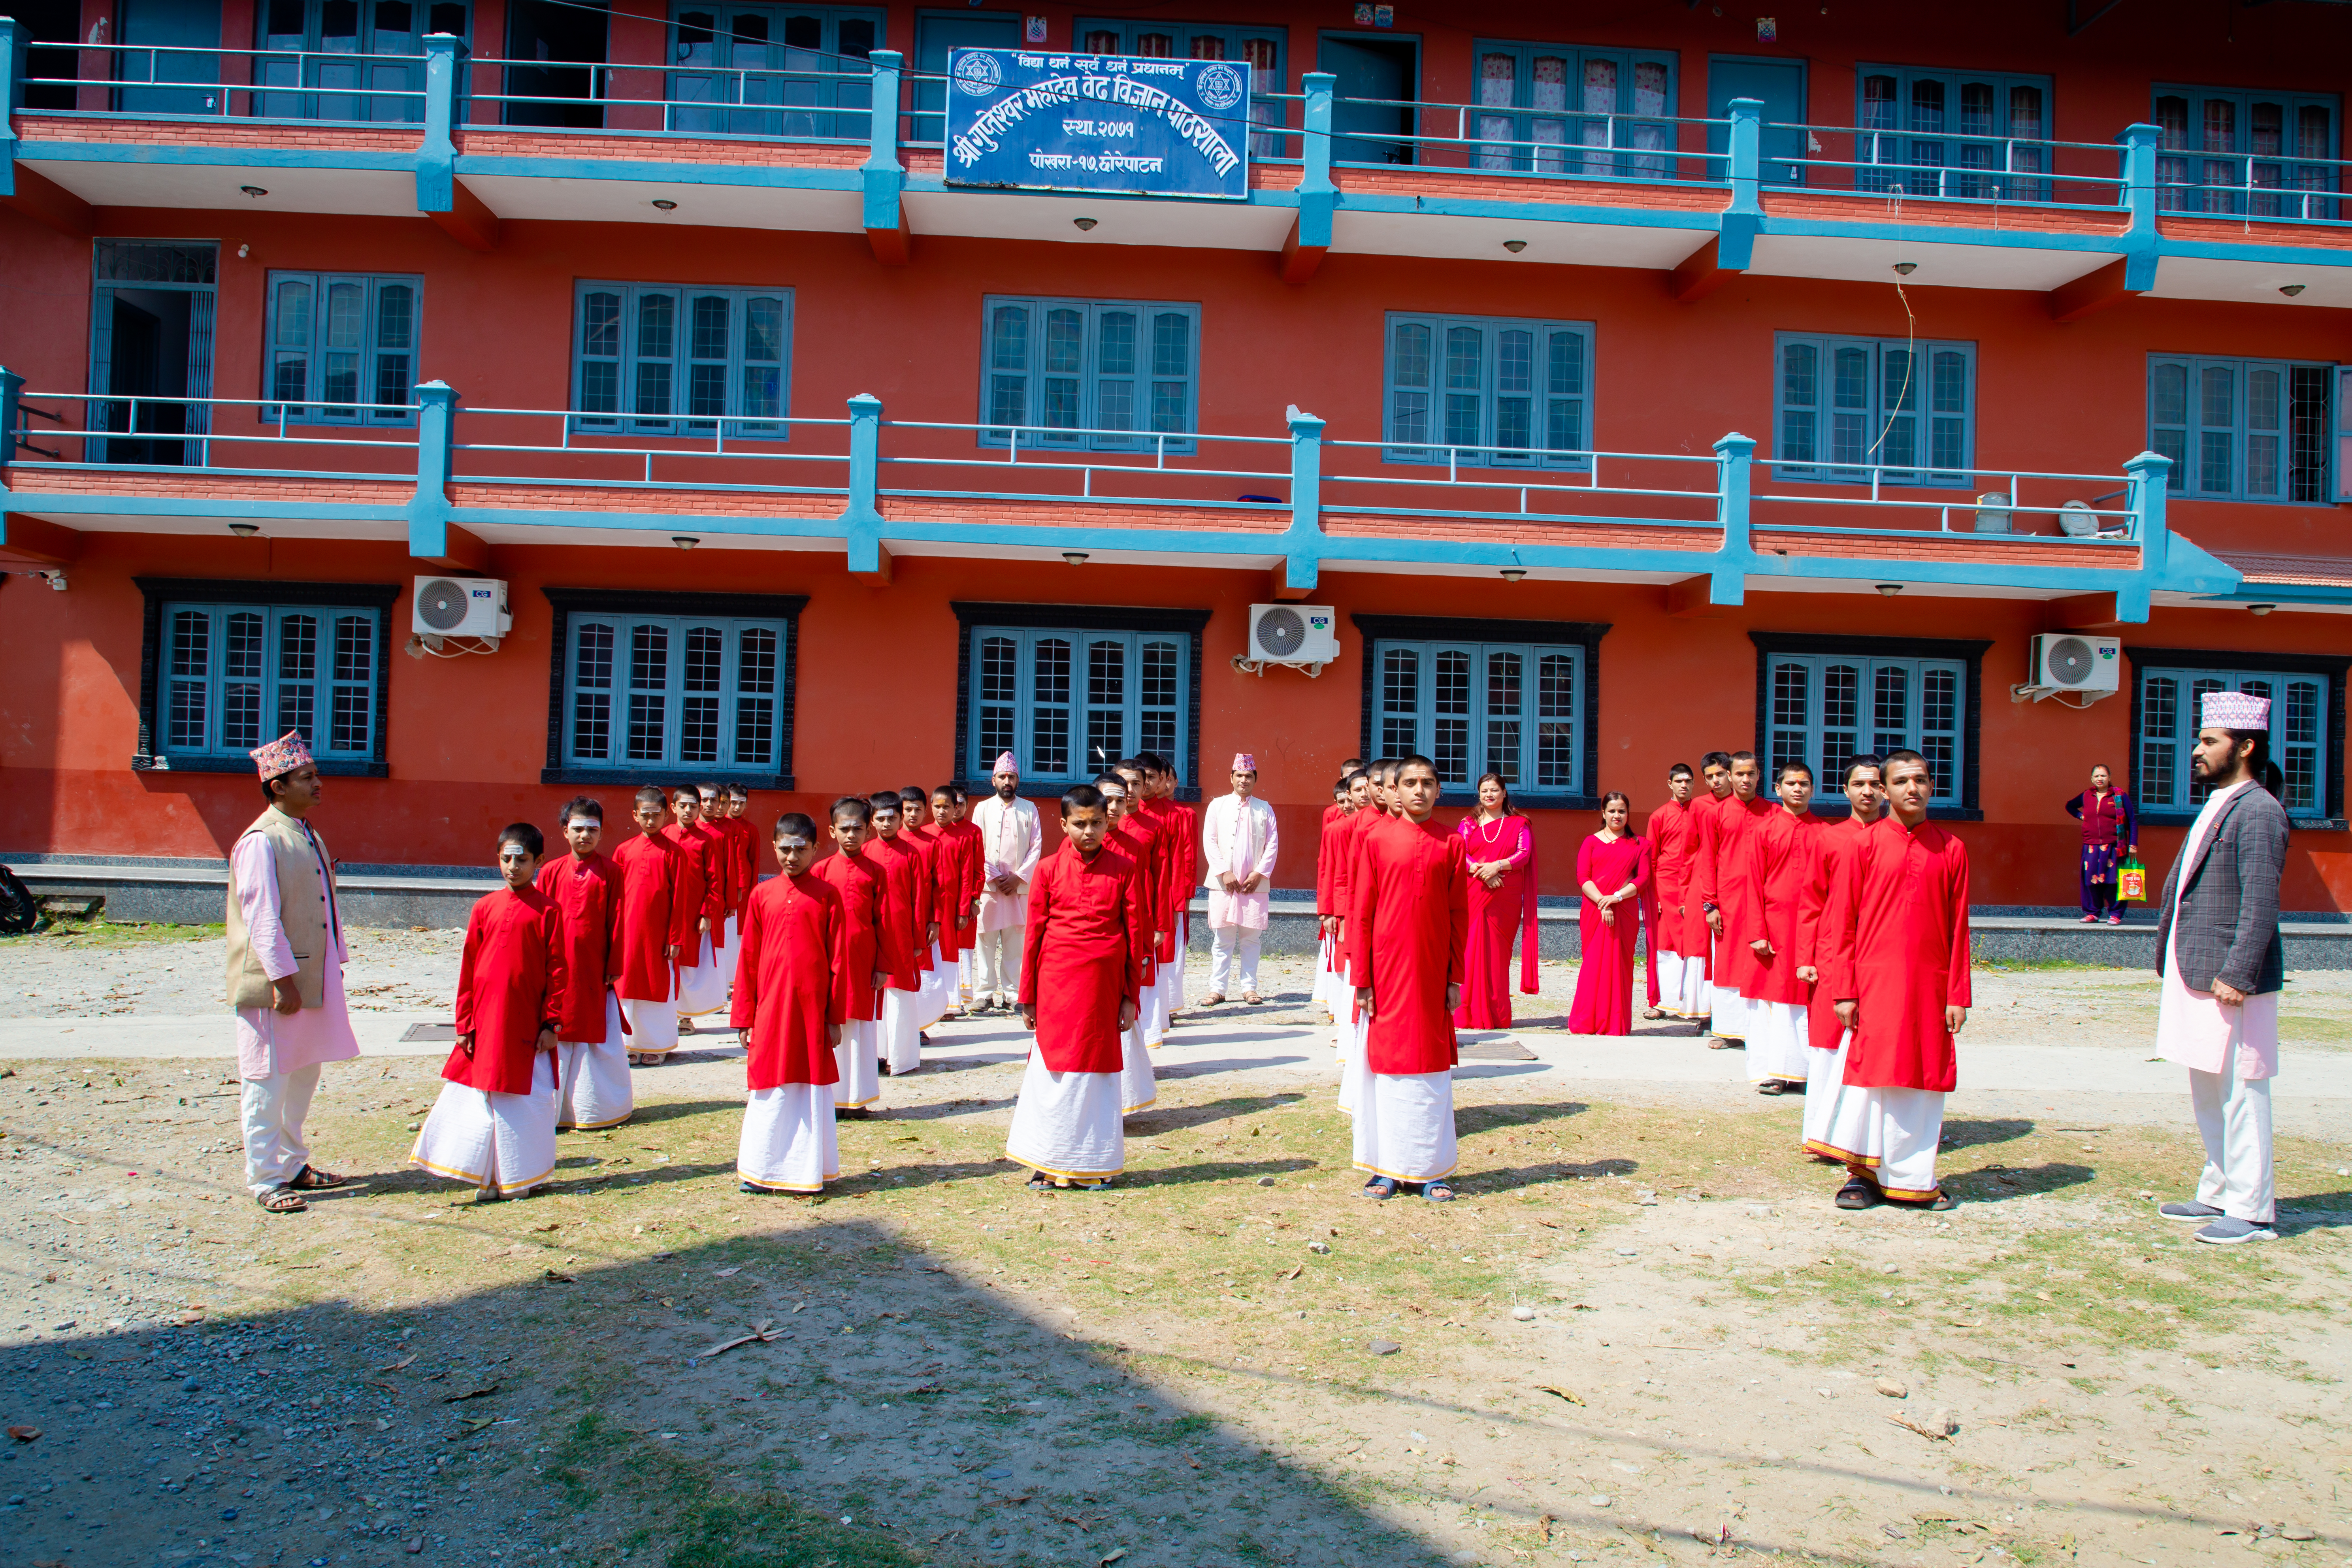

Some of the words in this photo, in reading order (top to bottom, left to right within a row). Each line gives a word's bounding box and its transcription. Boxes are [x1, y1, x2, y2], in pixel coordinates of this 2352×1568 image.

[1049, 56, 1070, 69] धनं
[1074, 56, 1100, 71] सर्व
[1106, 59, 1128, 73] धनं
[953, 135, 983, 168] श्री
[1022, 73, 1080, 109] महादेव
[1113, 74, 1170, 118] विज्ञान
[1167, 98, 1240, 179] पाठशाला
